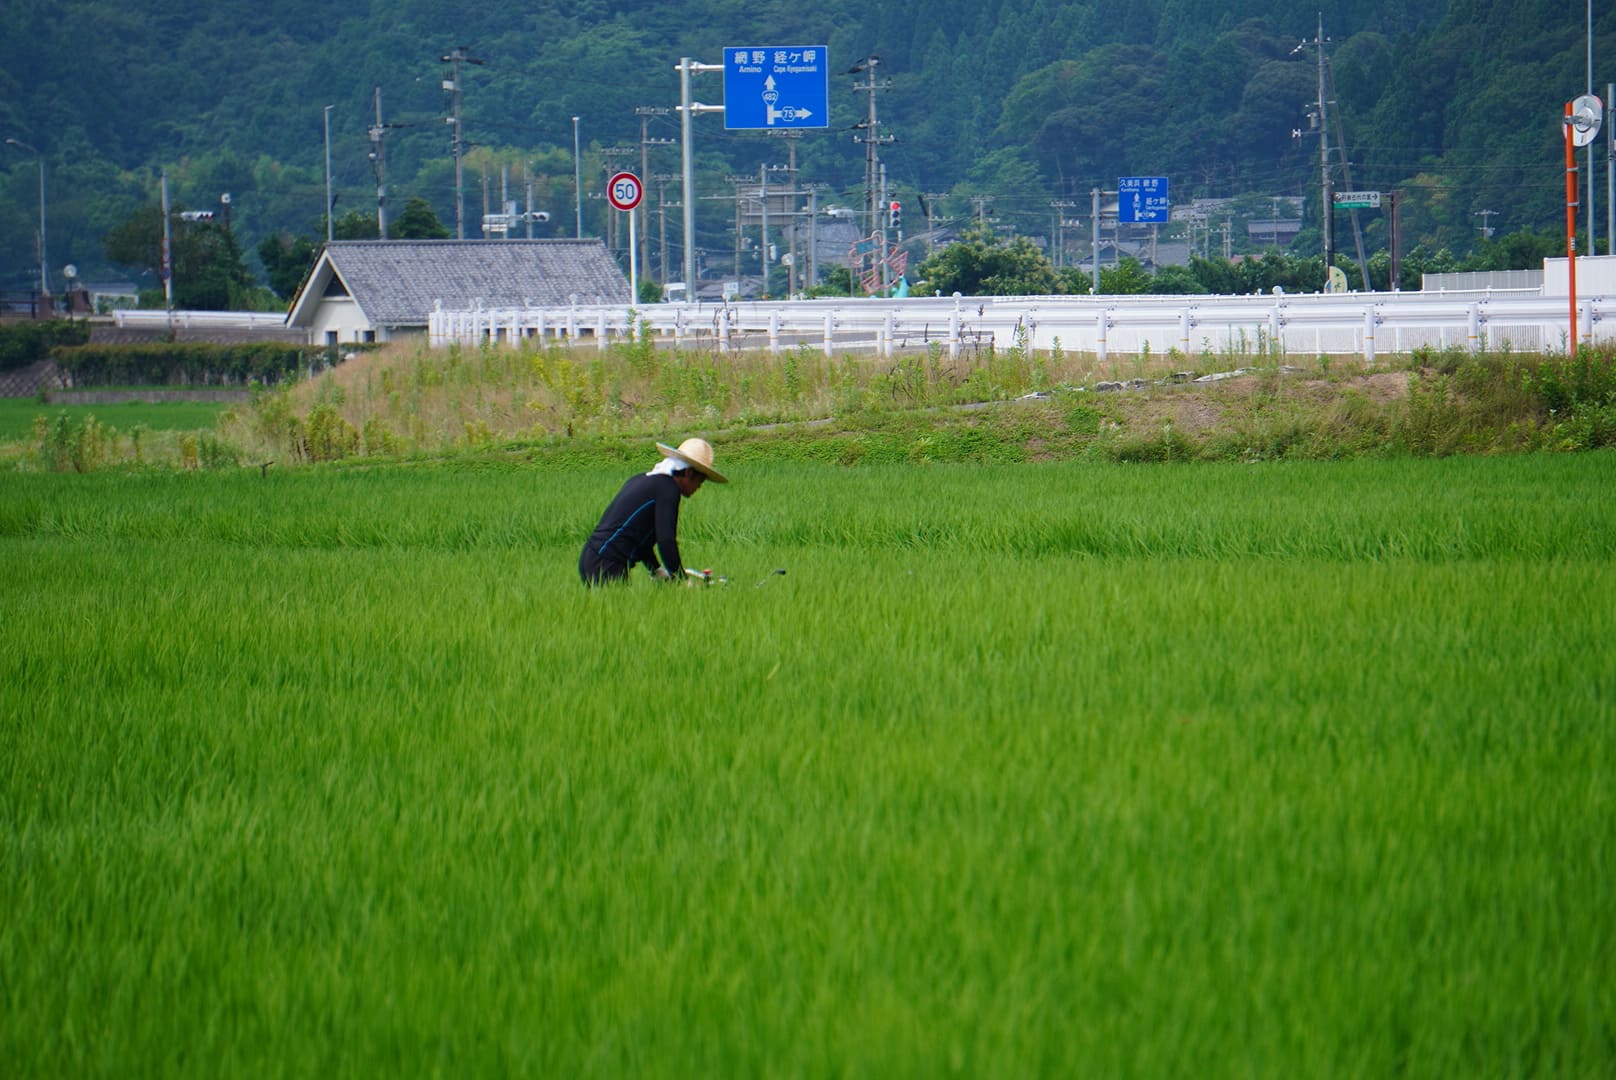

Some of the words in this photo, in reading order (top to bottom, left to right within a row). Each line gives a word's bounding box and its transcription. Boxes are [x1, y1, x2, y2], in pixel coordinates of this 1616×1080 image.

[734, 50, 766, 64] 網野
[738, 65, 762, 73] Amino
[773, 65, 786, 74] Cape
[764, 93, 777, 101] 482
[783, 110, 794, 118] 75
[616, 183, 635, 200] 50
